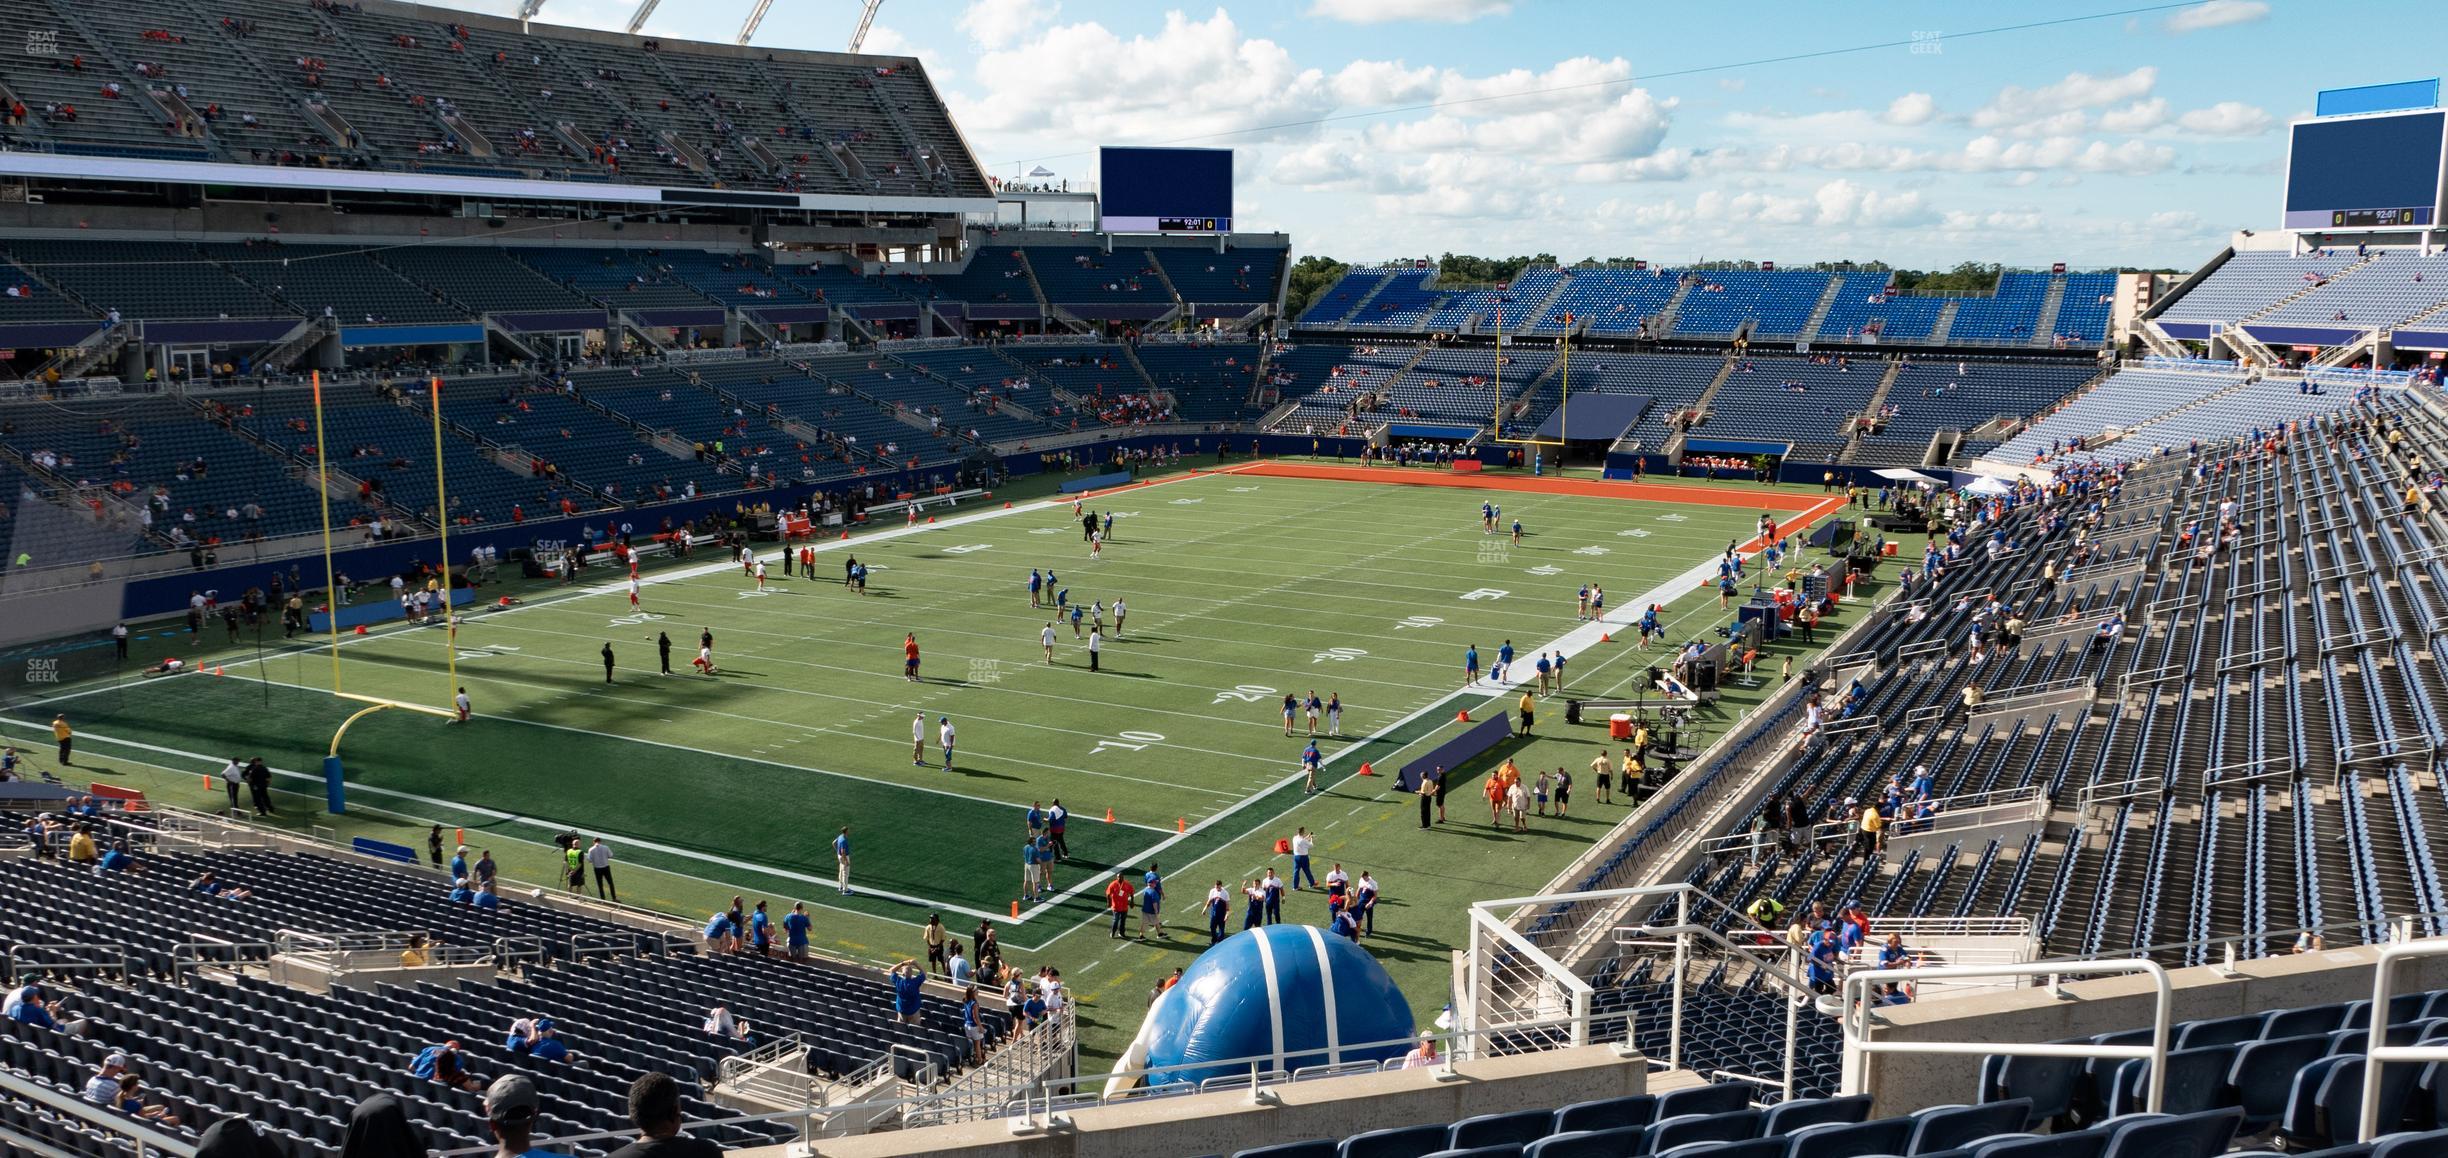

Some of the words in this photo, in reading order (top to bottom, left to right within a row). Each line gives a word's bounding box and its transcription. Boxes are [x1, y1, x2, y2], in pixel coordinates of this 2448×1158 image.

[2376, 210, 2397, 219] 92:01
[1184, 218, 1201, 226] 92:01
[1207, 220, 1213, 229] 0
[1314, 647, 1368, 662] 30
[1216, 684, 1278, 702] 20
[1098, 731, 1166, 752] 10
[1281, 840, 1289, 852] G
